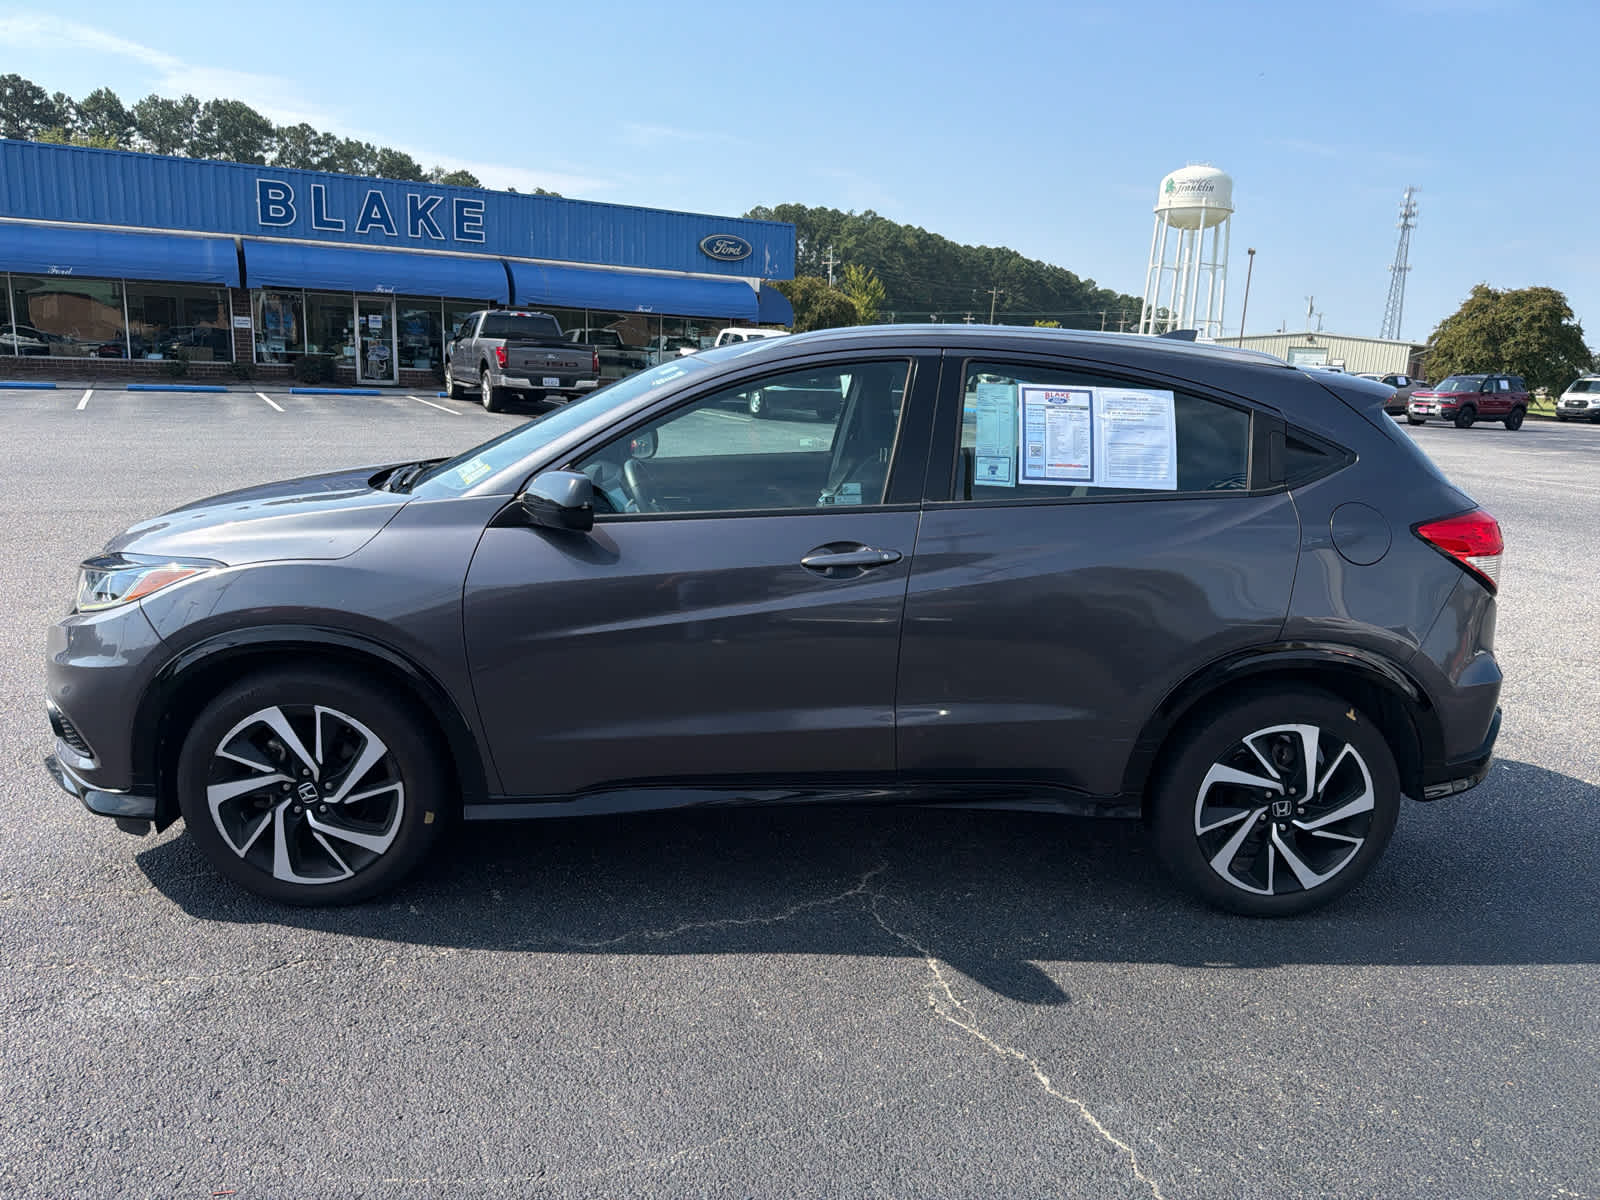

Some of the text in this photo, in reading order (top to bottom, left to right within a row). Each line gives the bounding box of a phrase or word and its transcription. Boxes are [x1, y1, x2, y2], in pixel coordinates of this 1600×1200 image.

[1175, 180, 1215, 194] Franklin
[256, 178, 486, 243] BLAKE
[712, 239, 743, 255] Ford
[1044, 391, 1071, 400] BLAKE
